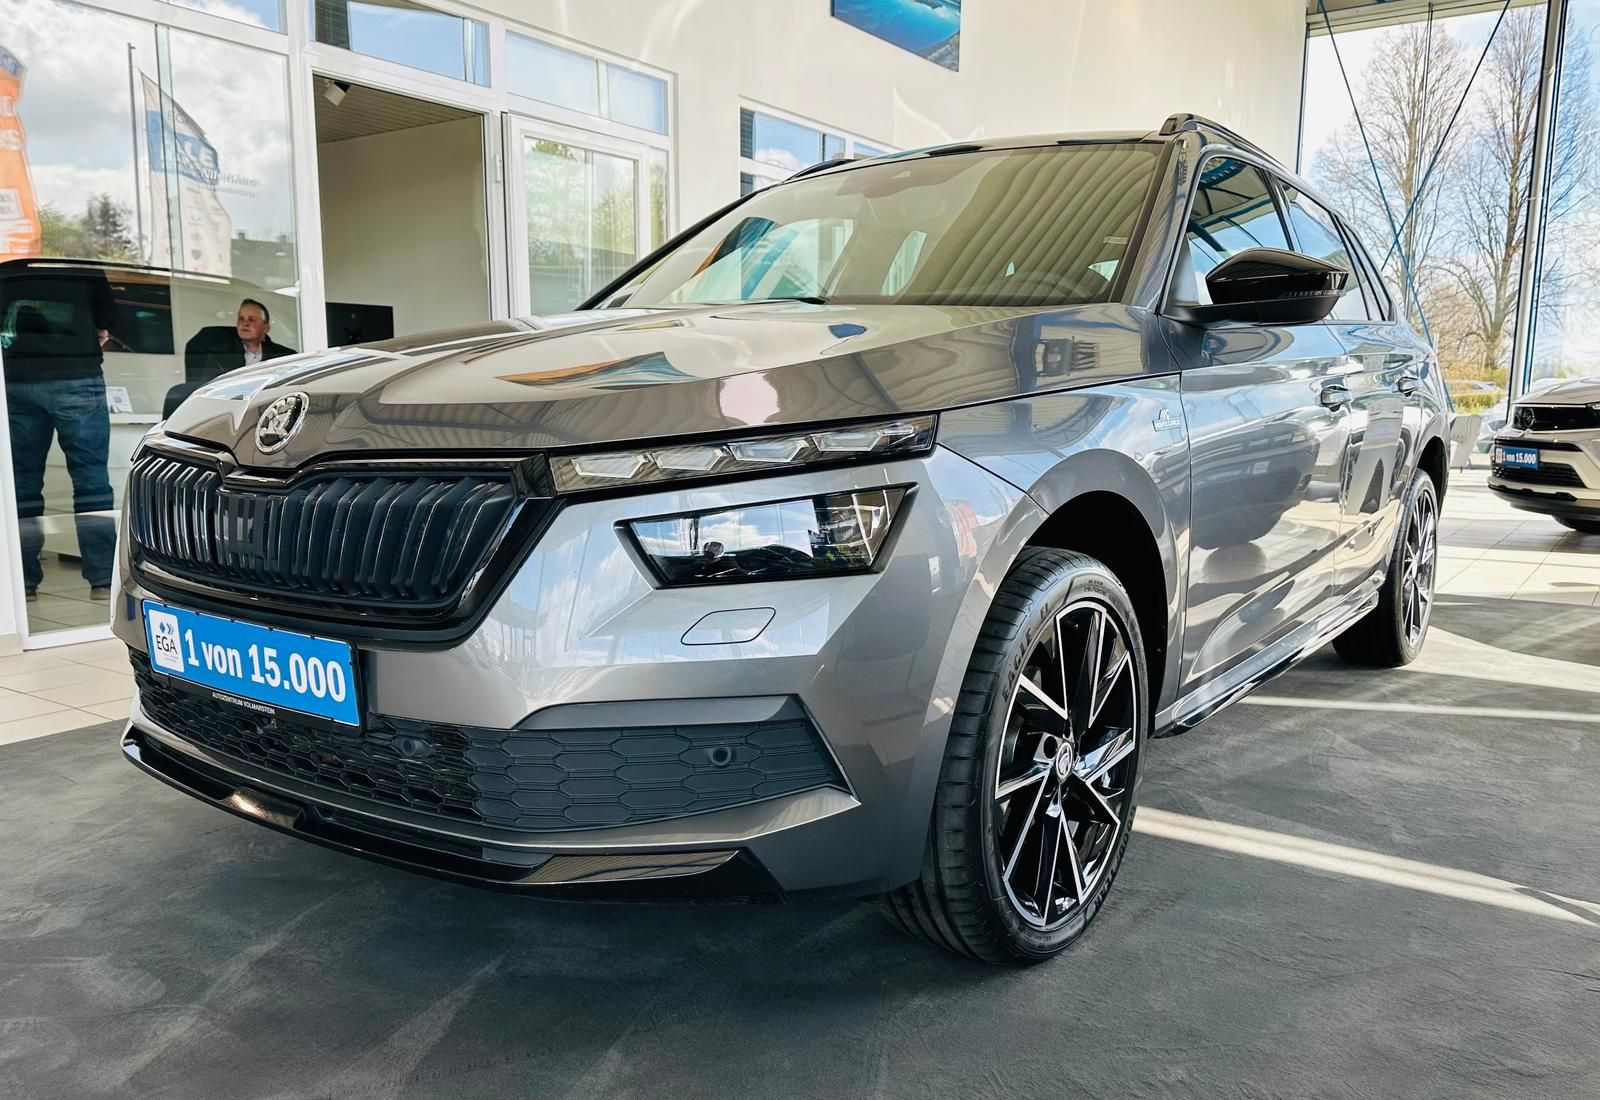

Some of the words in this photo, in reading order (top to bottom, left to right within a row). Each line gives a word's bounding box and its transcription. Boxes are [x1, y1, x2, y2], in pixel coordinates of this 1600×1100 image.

[156, 634, 178, 655] EGA
[184, 628, 200, 667] 1
[201, 641, 243, 678] von
[248, 643, 346, 703] 15.000
[243, 700, 276, 715] VOLMARSTEIN
